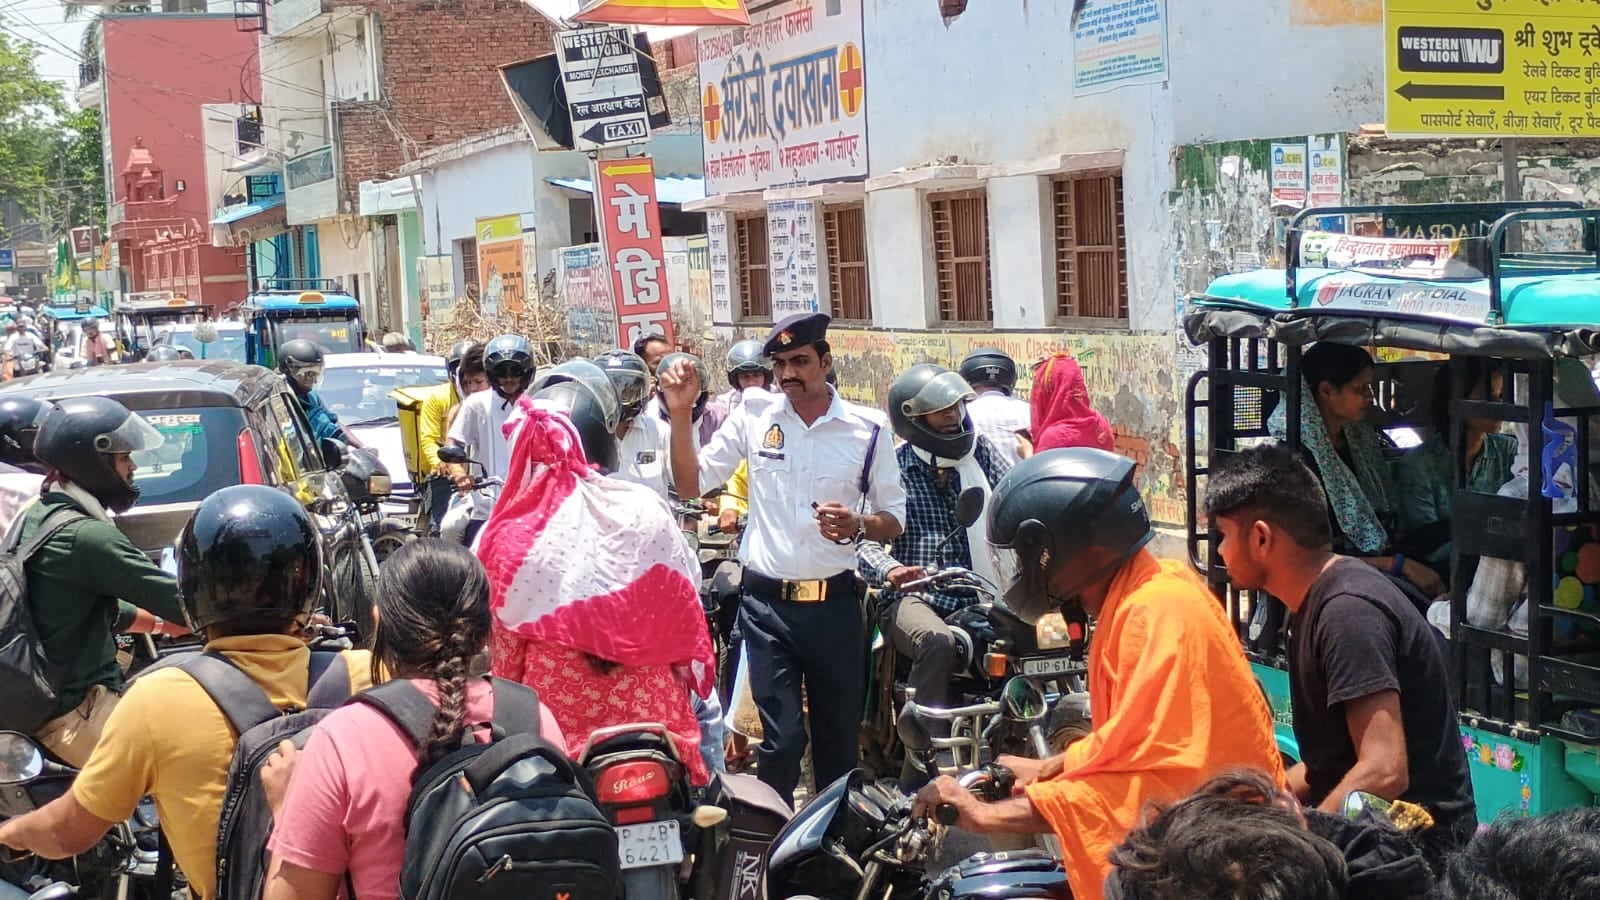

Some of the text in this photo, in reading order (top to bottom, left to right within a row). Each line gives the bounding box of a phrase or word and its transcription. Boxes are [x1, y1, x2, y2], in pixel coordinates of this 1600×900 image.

[562, 30, 619, 49] WESTERN
[1402, 37, 1459, 50] WESTERN
[1514, 22, 1536, 48] श्री
[1542, 30, 1573, 56] शुभ
[1420, 50, 1459, 63] UNION
[569, 64, 634, 81] MONEY EXCHANGE
[1523, 60, 1547, 78] रेलवे
[1551, 61, 1581, 78] टिकट
[769, 46, 840, 141] दवाखाना
[1524, 91, 1547, 105] एयर
[1551, 87, 1581, 104] टिकट
[574, 103, 589, 117] रेल
[591, 100, 623, 114] आरक्षण
[608, 121, 640, 136] TAXI
[1420, 109, 1464, 128] पासपोर्ट
[1569, 116, 1583, 134] दूर
[1337, 284, 1395, 301] JAGRAN
[1431, 288, 1467, 301] DIAL
[1036, 661, 1050, 673] UP
